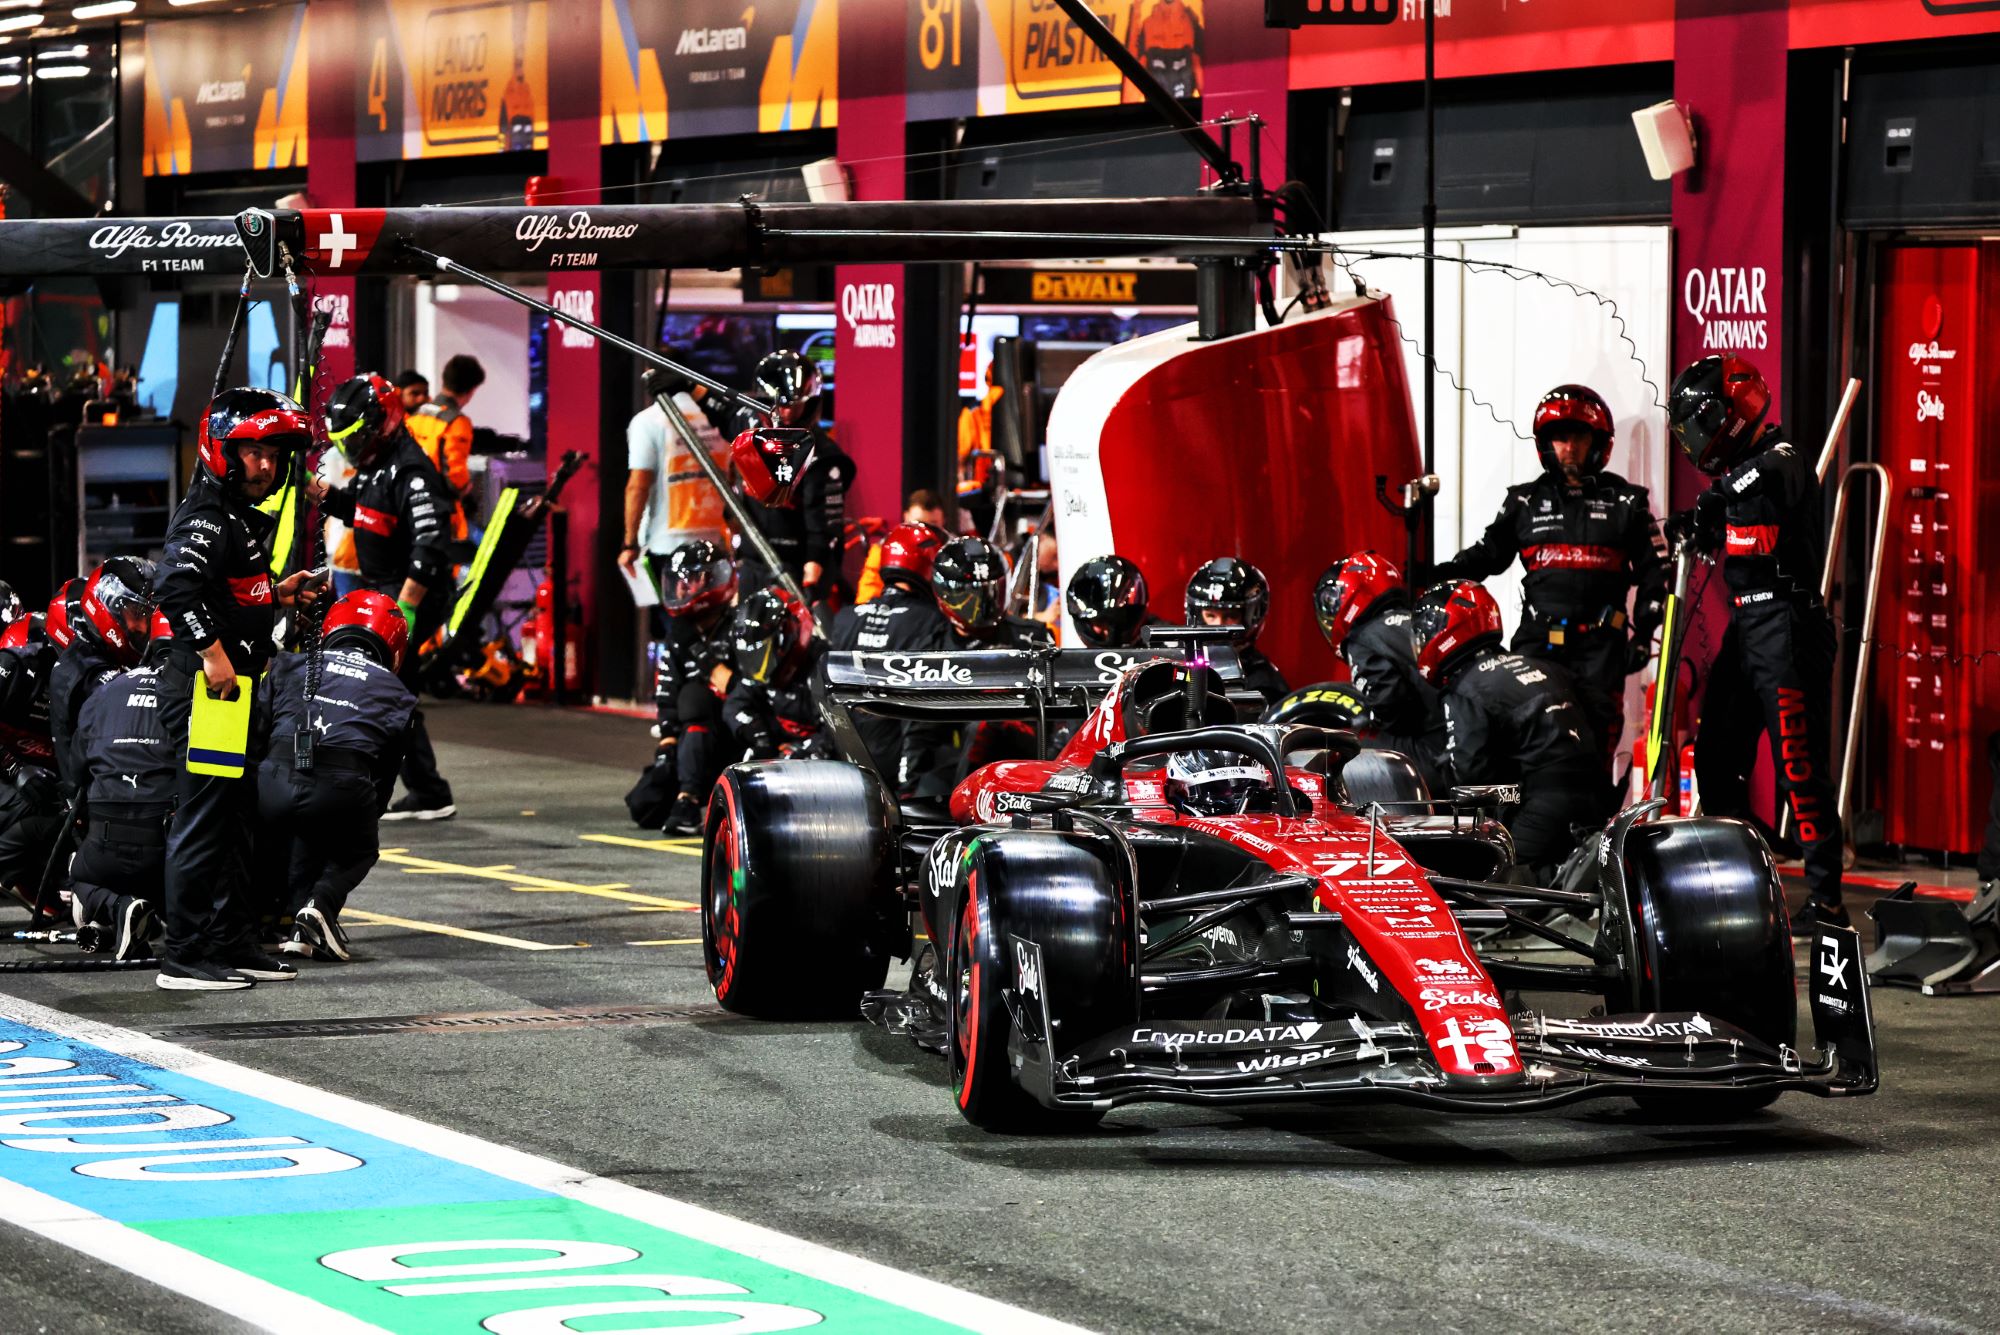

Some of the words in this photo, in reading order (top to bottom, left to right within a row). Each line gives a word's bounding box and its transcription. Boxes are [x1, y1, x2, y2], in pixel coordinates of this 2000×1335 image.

[675, 27, 747, 55] McLaren
[368, 38, 388, 132] 4
[431, 79, 489, 122] NORRIS
[89, 225, 157, 259] Alfa
[516, 214, 566, 252] Alfa
[566, 211, 639, 239] Romeo
[142, 260, 158, 271] F1
[162, 259, 204, 271] TEAM
[550, 254, 562, 266] F1
[567, 253, 598, 266] TEAM
[842, 283, 895, 329] QATAR
[1685, 267, 1767, 325] QATAR
[1703, 320, 1768, 350] AIRWAYS
[256, 416, 278, 430] Stake
[1731, 467, 1760, 494] KICK
[189, 519, 221, 535] Hyland
[183, 611, 207, 640] KICK
[325, 661, 369, 681] KICK
[883, 654, 973, 687] Stake
[1778, 687, 1812, 783] CREW
[997, 793, 1033, 811] Stake
[1498, 786, 1521, 805] Stake
[1790, 790, 1825, 843] PIT
[929, 832, 963, 898] Sta
[1312, 860, 1406, 877] 77
[1415, 974, 1482, 982] SINGHA
[1420, 988, 1502, 1011] Stake
[1131, 1026, 1300, 1049] CryptoDATA
[1565, 1018, 1701, 1038] CryptoDATA
[1236, 1046, 1336, 1074] Wispr
[1565, 1044, 1653, 1066] Wispr
[0, 1038, 368, 1182] aram
